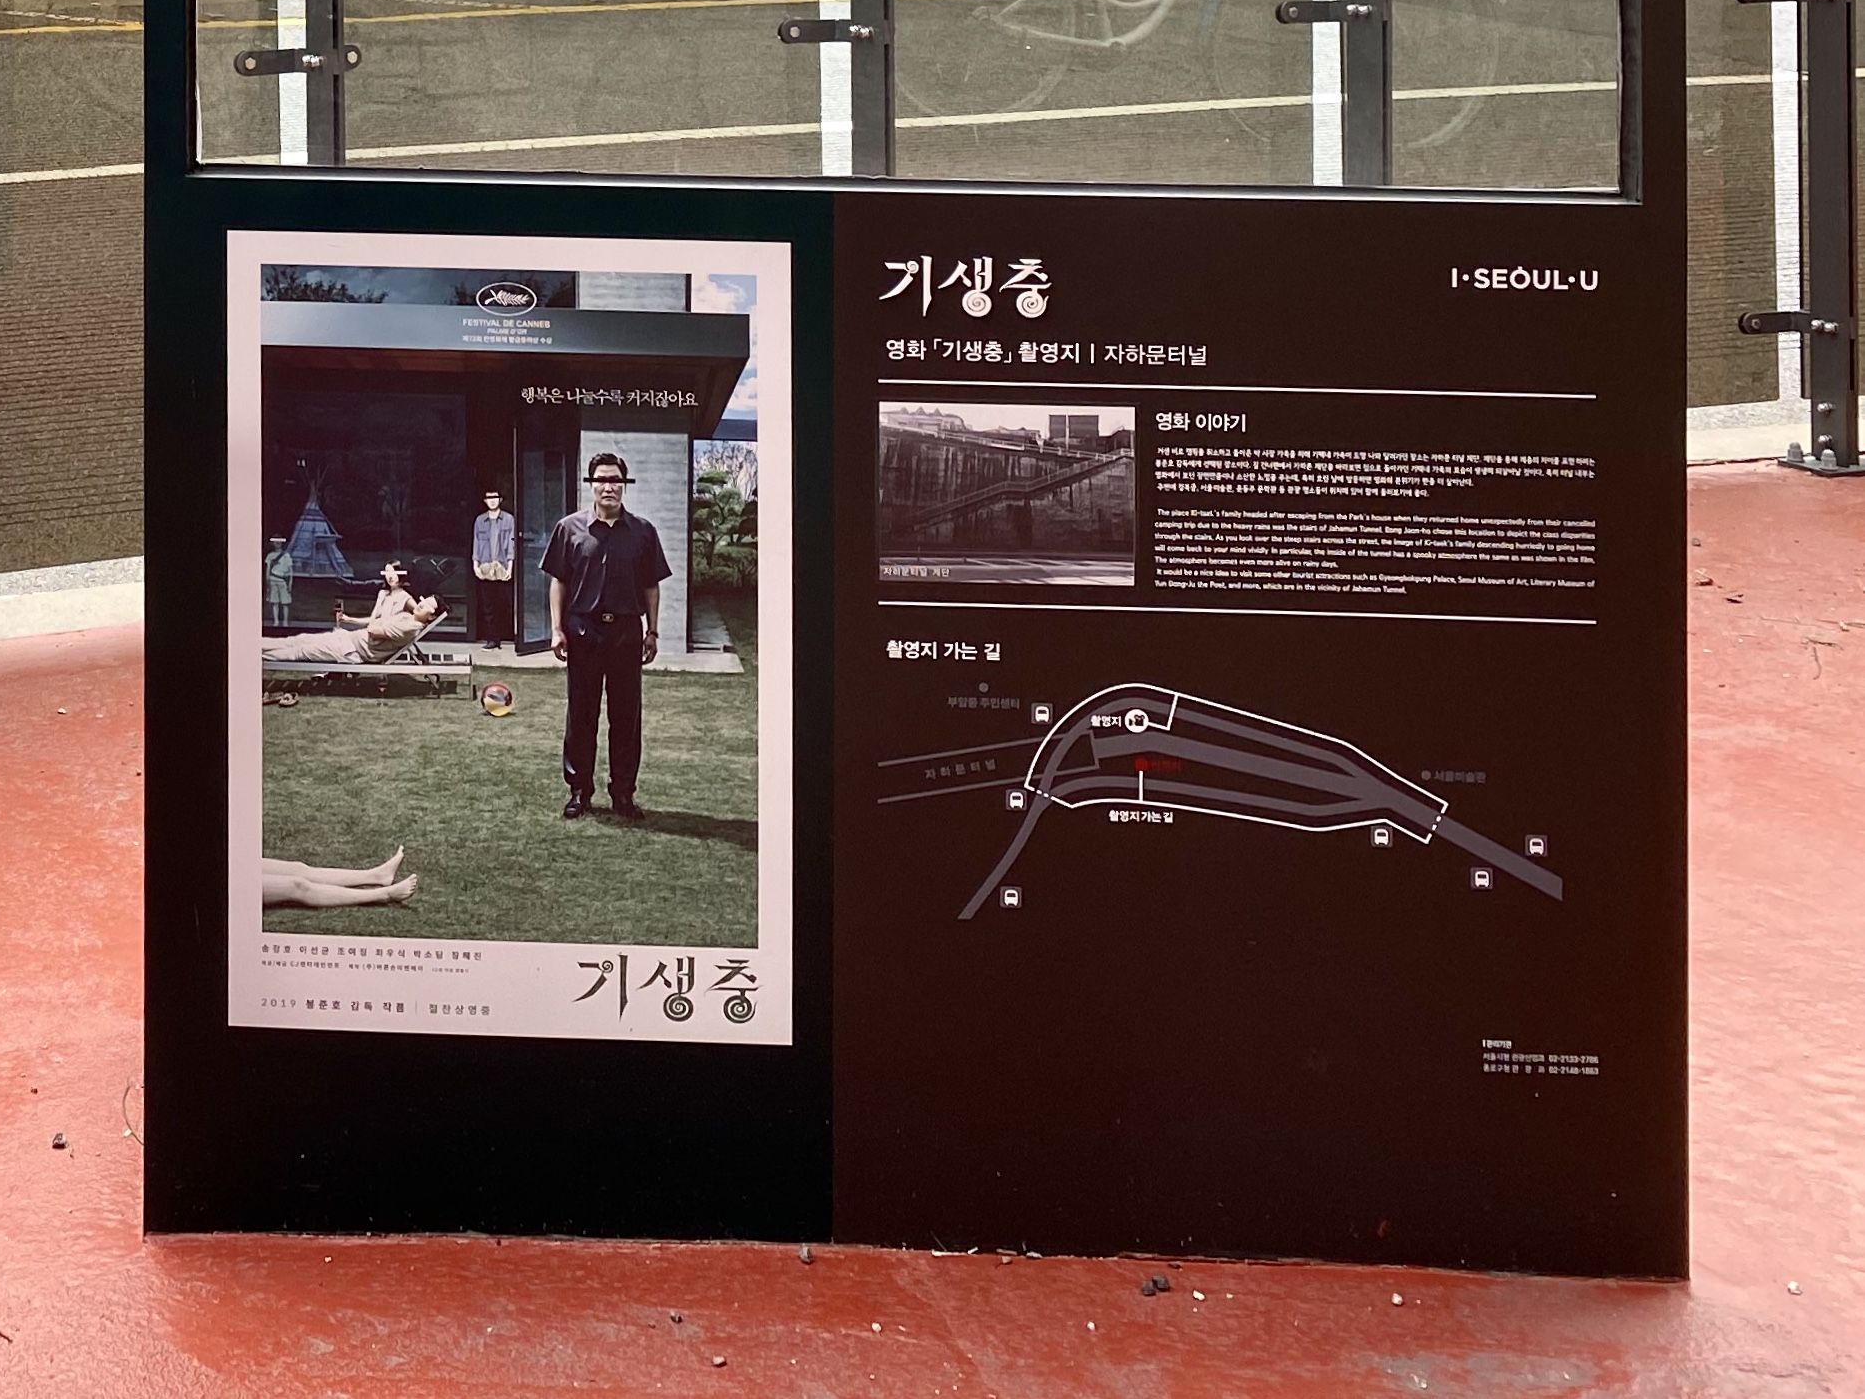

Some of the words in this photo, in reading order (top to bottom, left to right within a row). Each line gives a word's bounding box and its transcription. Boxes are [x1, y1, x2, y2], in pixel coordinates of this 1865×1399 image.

[878, 254, 1053, 319] 기생충
[462, 318, 501, 327] FESTIVAL
[503, 320, 515, 328] DE
[516, 320, 551, 329] CANNES
[885, 339, 928, 362] 영화
[1017, 341, 1080, 364] 촬영지
[1103, 344, 1208, 367] 자하문터널
[521, 386, 565, 405] 행복은
[566, 387, 625, 407] 나눌수록
[626, 389, 699, 408] 커지잖아요
[1155, 412, 1191, 432] 영화
[1195, 413, 1247, 433] 이야기
[886, 640, 938, 660] 촬영지
[943, 642, 978, 661] 가는
[984, 643, 1001, 661] 길
[1090, 715, 1122, 728] 촬영지
[1108, 809, 1140, 823] 촬영지
[1141, 810, 1162, 823] 가는
[1163, 811, 1174, 823] 길
[261, 944, 292, 954] 송강호
[299, 945, 330, 955] 이선균
[375, 948, 406, 958] 최우식
[413, 950, 444, 960] 박소담
[572, 952, 763, 1025] 기생충
[261, 998, 297, 1009] 2019
[305, 999, 342, 1011] 봉준호
[350, 1001, 374, 1012] 감독
[382, 1002, 405, 1013] 작품
[428, 1003, 492, 1016] 절찬상영중
